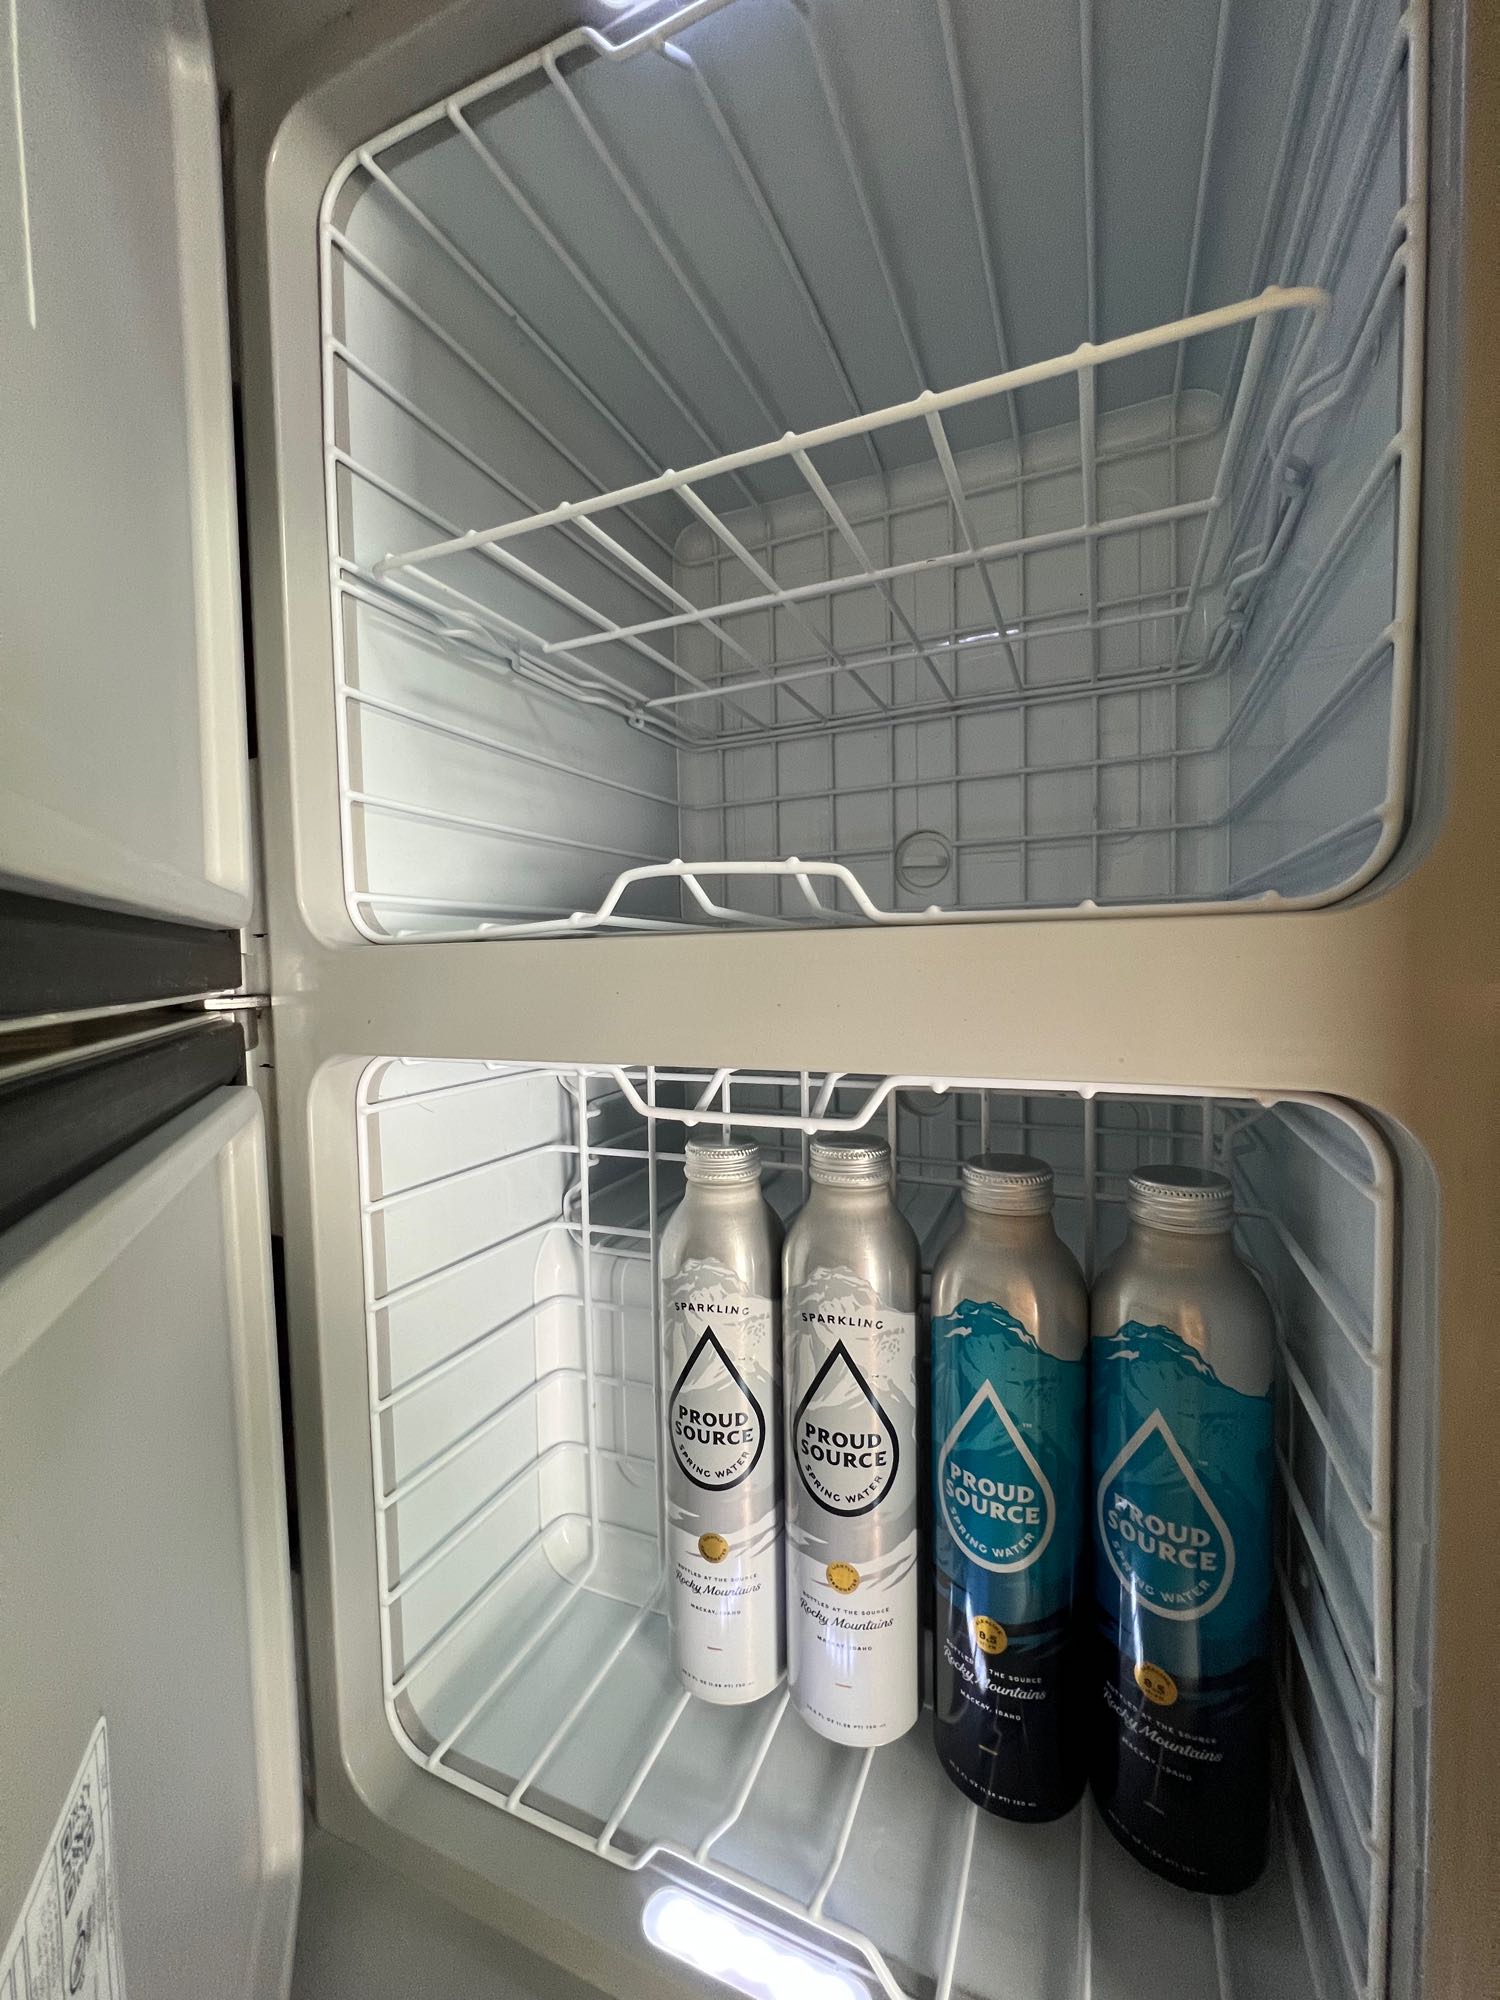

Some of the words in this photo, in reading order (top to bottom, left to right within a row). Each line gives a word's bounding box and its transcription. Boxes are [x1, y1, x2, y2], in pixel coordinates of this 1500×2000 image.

[674, 1302, 750, 1316] SPARKLING
[801, 1312, 885, 1330] SPARKLING
[675, 1421, 754, 1445] SOURCE
[679, 1404, 749, 1428] PROUD
[805, 1422, 882, 1449] PROUD
[679, 1443, 711, 1478] SPRING
[715, 1451, 750, 1479] WATER
[801, 1439, 887, 1469] SOURCE
[805, 1463, 841, 1502] SPRING
[845, 1475, 883, 1504] WATER
[950, 1461, 1035, 1504] PROUD
[945, 1478, 1040, 1525] SOURCE
[950, 1506, 988, 1554] SPRING
[991, 1532, 1035, 1558] WATER
[1114, 1492, 1211, 1548] PROUD
[1108, 1510, 1218, 1572] SOURCE
[675, 1569, 702, 1596] Rocky
[703, 1583, 762, 1597] Mountains
[1112, 1540, 1155, 1596] SPRNG
[1160, 1579, 1210, 1604] WATER
[800, 1597, 829, 1626] Rocky
[831, 1617, 894, 1631] Mountains
[943, 1644, 975, 1685] Rocky
[988, 1668, 1005, 1679] THE
[995, 1708, 1021, 1721] IDAHO
[1139, 1725, 1223, 1762] Mountains
